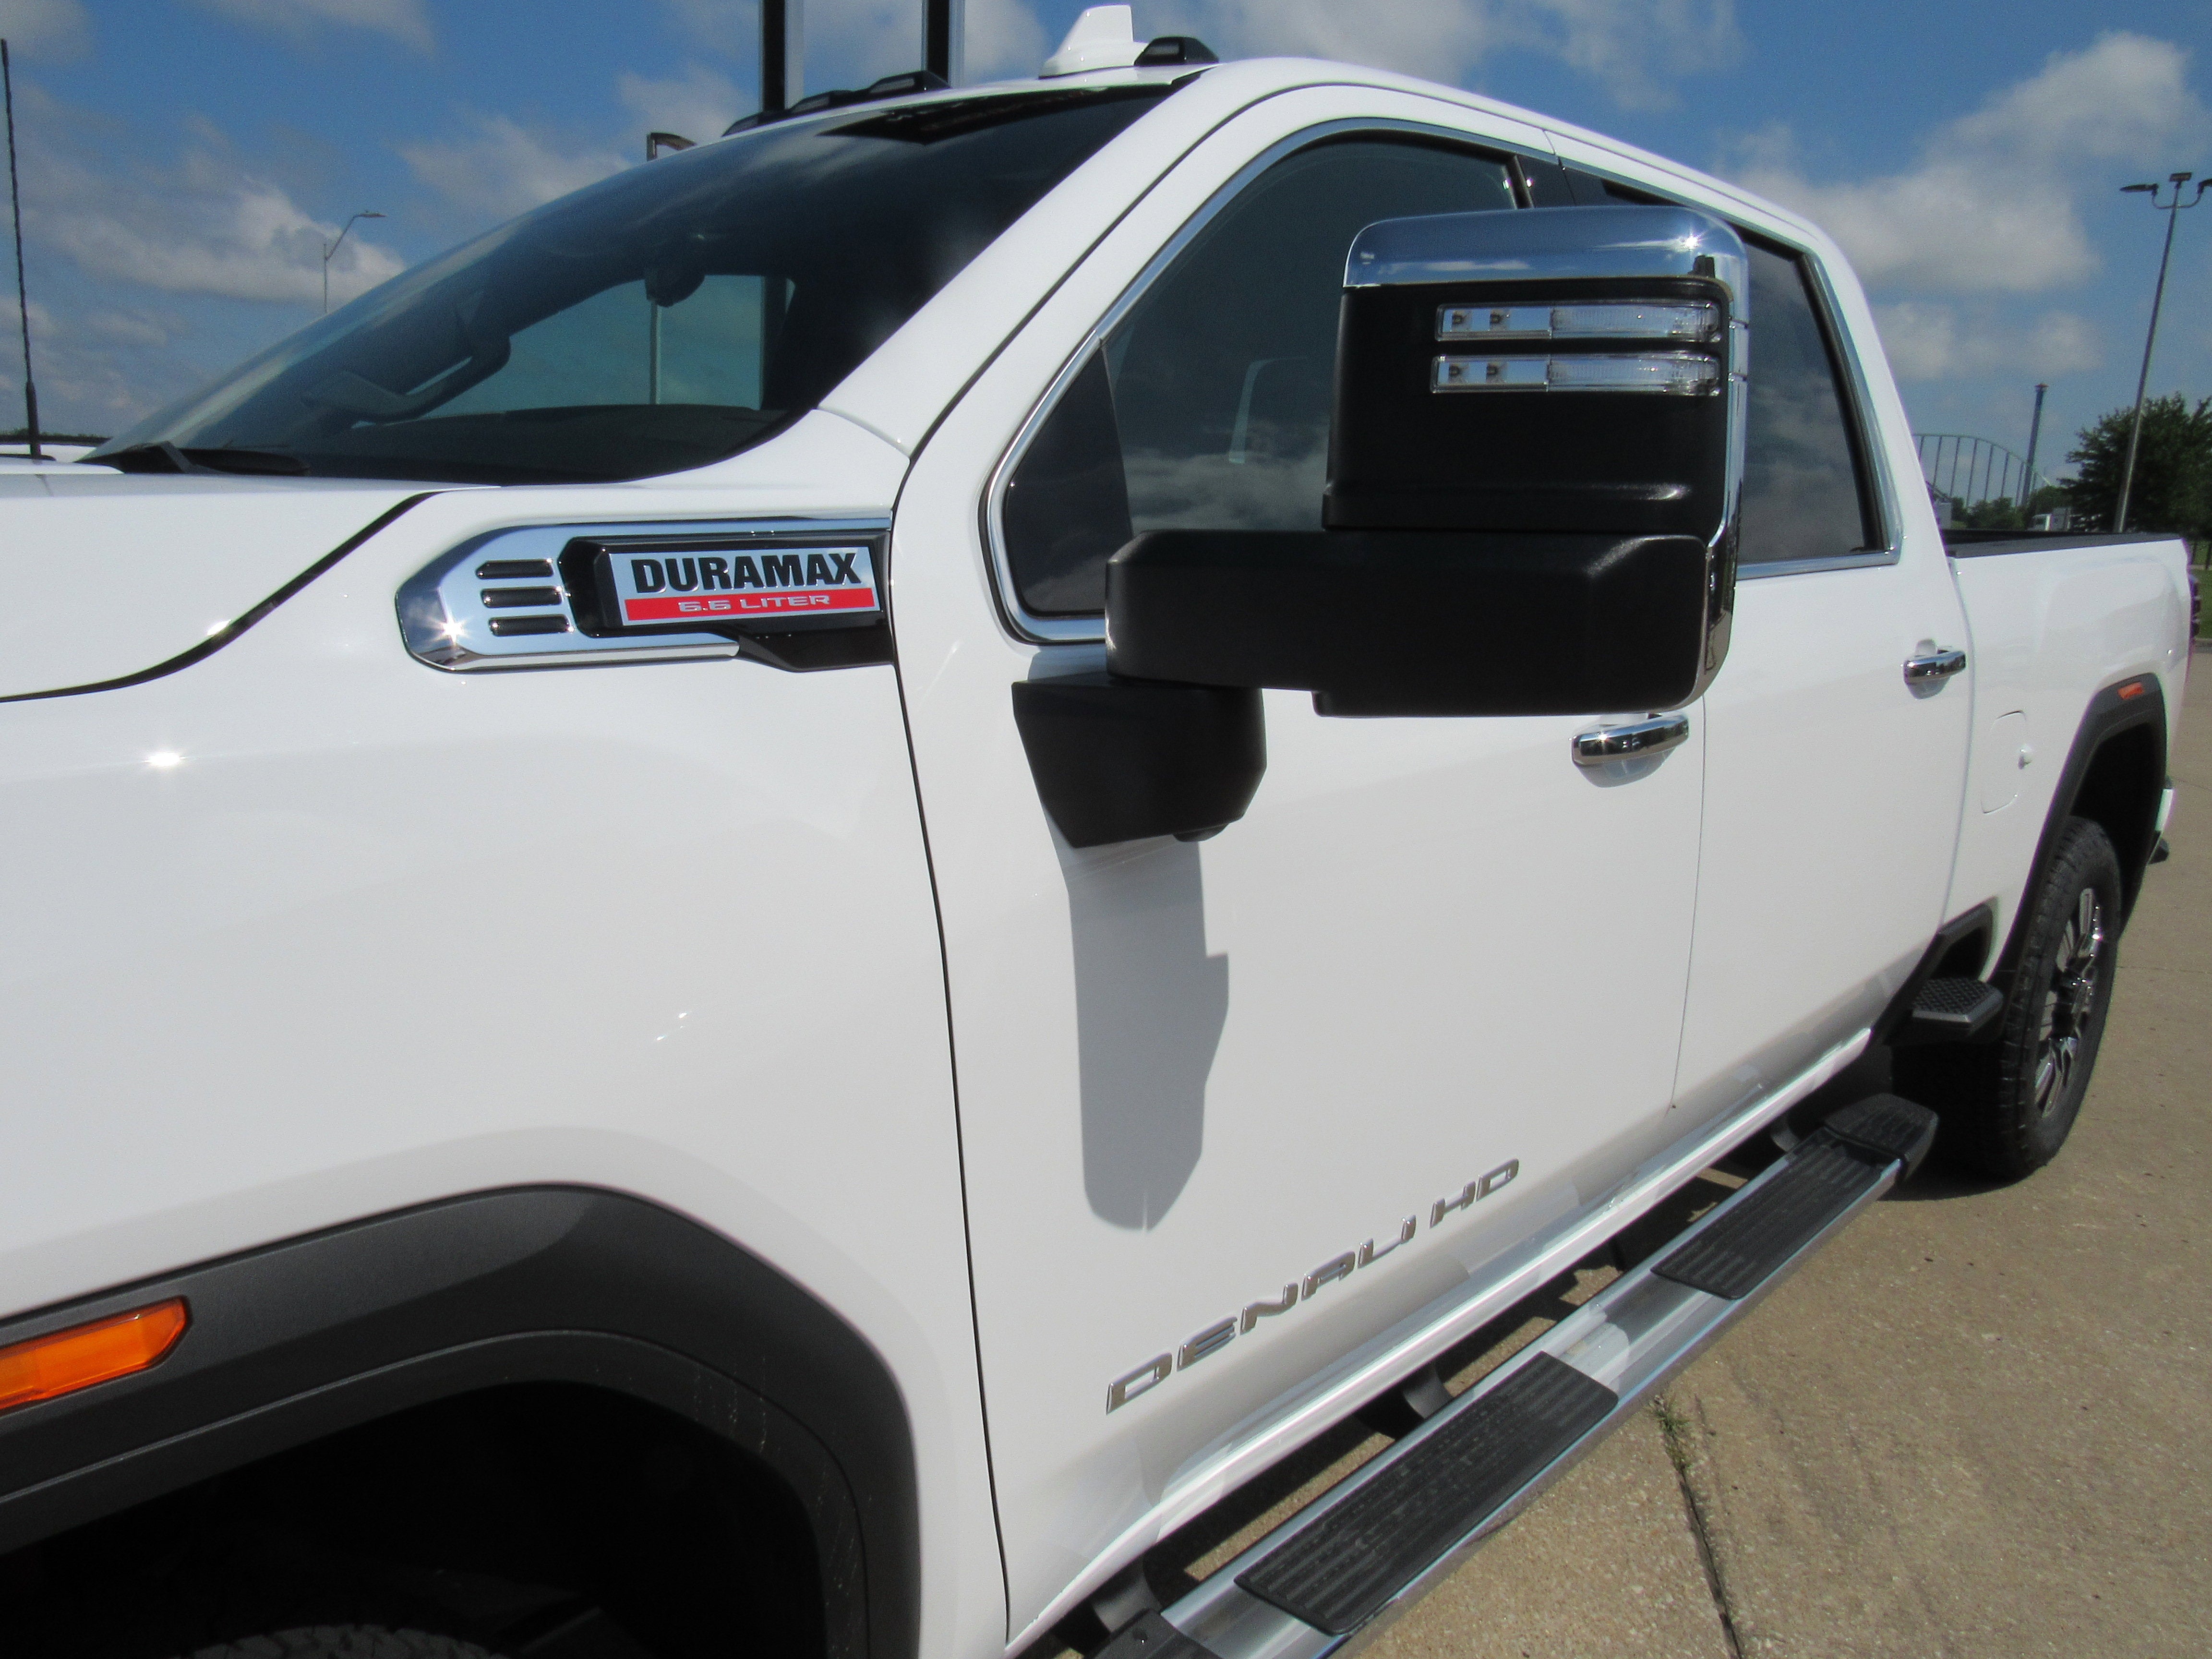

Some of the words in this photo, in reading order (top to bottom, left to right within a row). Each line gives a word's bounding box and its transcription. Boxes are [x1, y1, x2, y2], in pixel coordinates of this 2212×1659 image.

[631, 553, 861, 593] DURAMAX
[678, 601, 730, 613] 6.6
[739, 594, 831, 609] LITER
[1106, 1215, 1416, 1415] DENALI
[1430, 1158, 1519, 1229] HD
